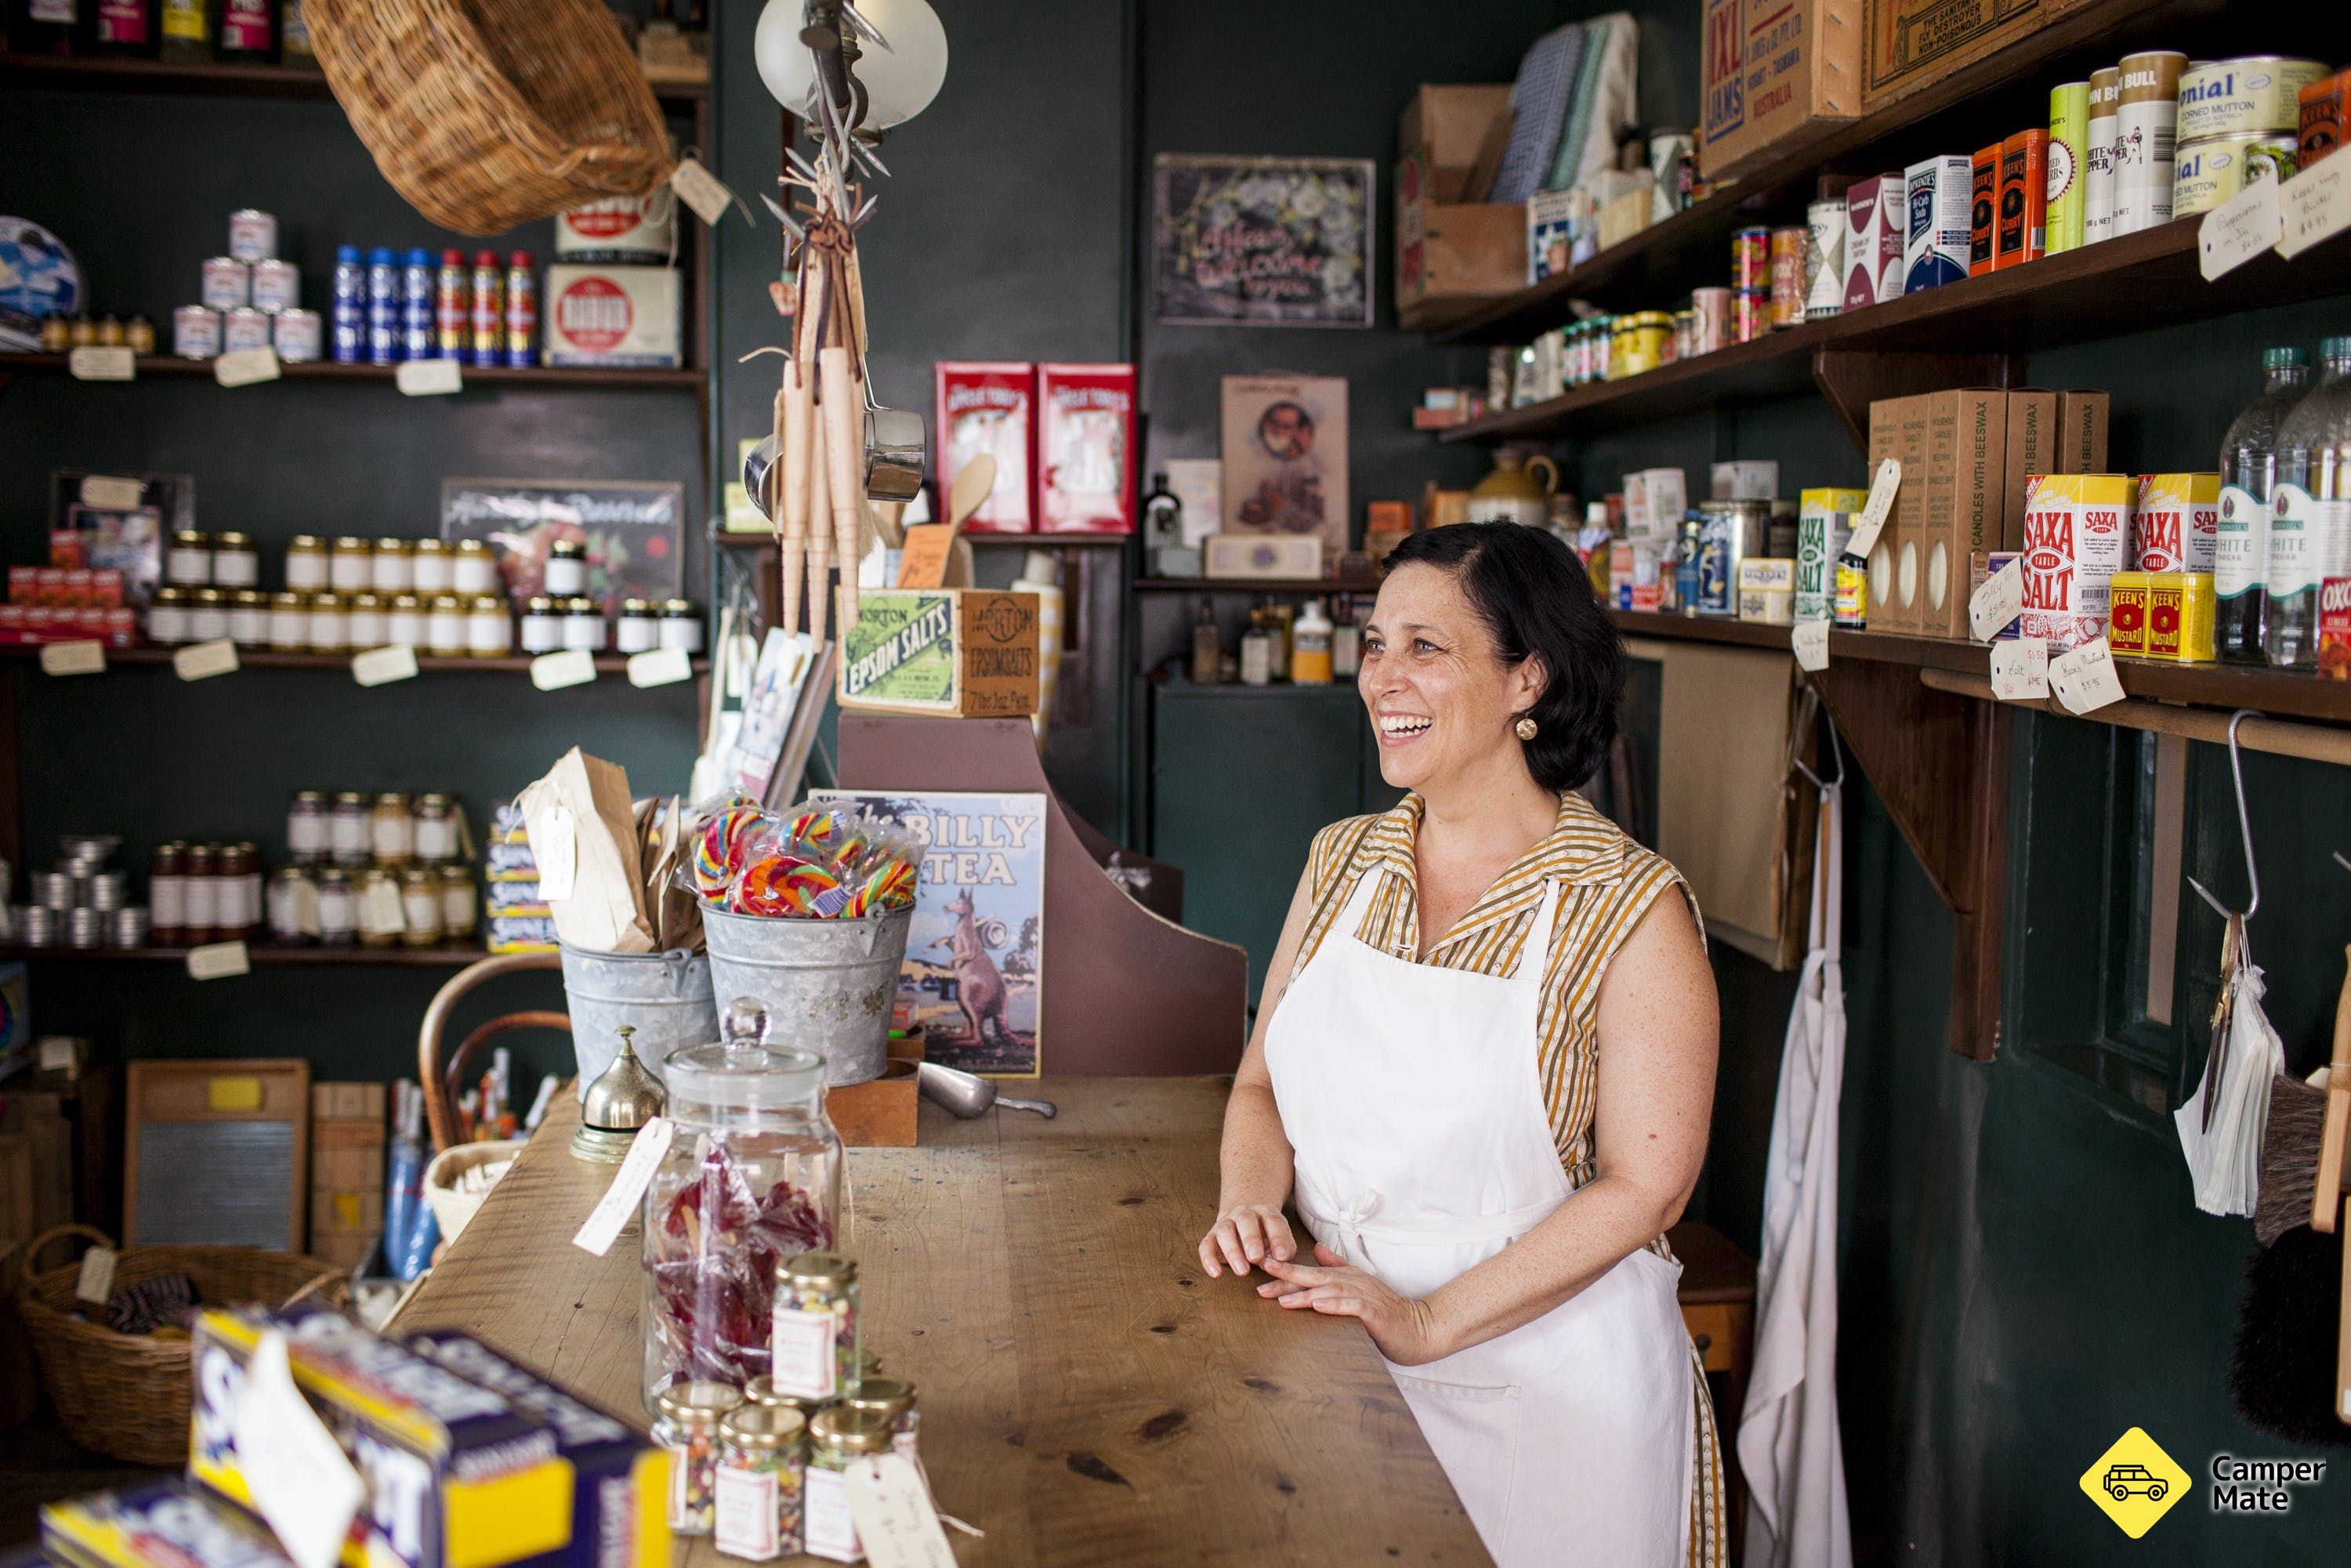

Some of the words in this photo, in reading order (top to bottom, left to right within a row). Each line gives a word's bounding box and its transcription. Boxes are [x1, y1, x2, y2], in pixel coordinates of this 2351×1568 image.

[1918, 29, 1931, 44] FLY
[1934, 2, 1981, 36] DESTROYER
[1923, 14, 1937, 30] THE
[1710, 2, 1741, 88] IXL
[1918, 14, 1982, 57] NON-POISONOUS
[2125, 71, 2157, 88] BULL
[2179, 72, 2234, 108] onial
[1708, 77, 1742, 131] JAMS
[1753, 81, 1792, 119] AUSTRALIA
[2182, 106, 2210, 122] CORNED
[2212, 100, 2255, 114] MUTTON
[2088, 146, 2106, 161] HITE
[2003, 158, 2024, 178] KEEN'S
[2087, 158, 2109, 173] EPPER
[1972, 171, 1994, 191] KEEN'S
[2184, 181, 2218, 194] MUTTON
[1972, 223, 1991, 242] CURRY
[2001, 212, 2023, 233] CURRY
[1975, 401, 1987, 458] BEESWAX
[2026, 403, 2038, 460] BEESWAX
[2081, 404, 2093, 460] BEESWAX
[1973, 461, 1985, 491] WITH
[1972, 491, 1984, 547] CANDLES
[2085, 512, 2118, 531] SAXA
[2193, 511, 2218, 531] SAX
[2024, 512, 2075, 561] SAXA
[2136, 512, 2183, 563] SAXA
[2034, 555, 2056, 567] TABLE
[2145, 556, 2164, 568] TABLE
[2021, 564, 2074, 611] SALT
[2322, 581, 2351, 613] OXO
[2113, 590, 2145, 610] KEEN'S
[2152, 592, 2181, 611] KEEN'S
[2111, 625, 2143, 644] MUSTARD
[2150, 628, 2179, 647] MUSTARD
[849, 636, 900, 695] EPSOM
[900, 603, 947, 661] SALTS
[2027, 646, 2046, 664] $1.50
[2007, 659, 2025, 676] Salt
[904, 813, 1038, 849] BILLY
[922, 851, 1018, 886] TEA
